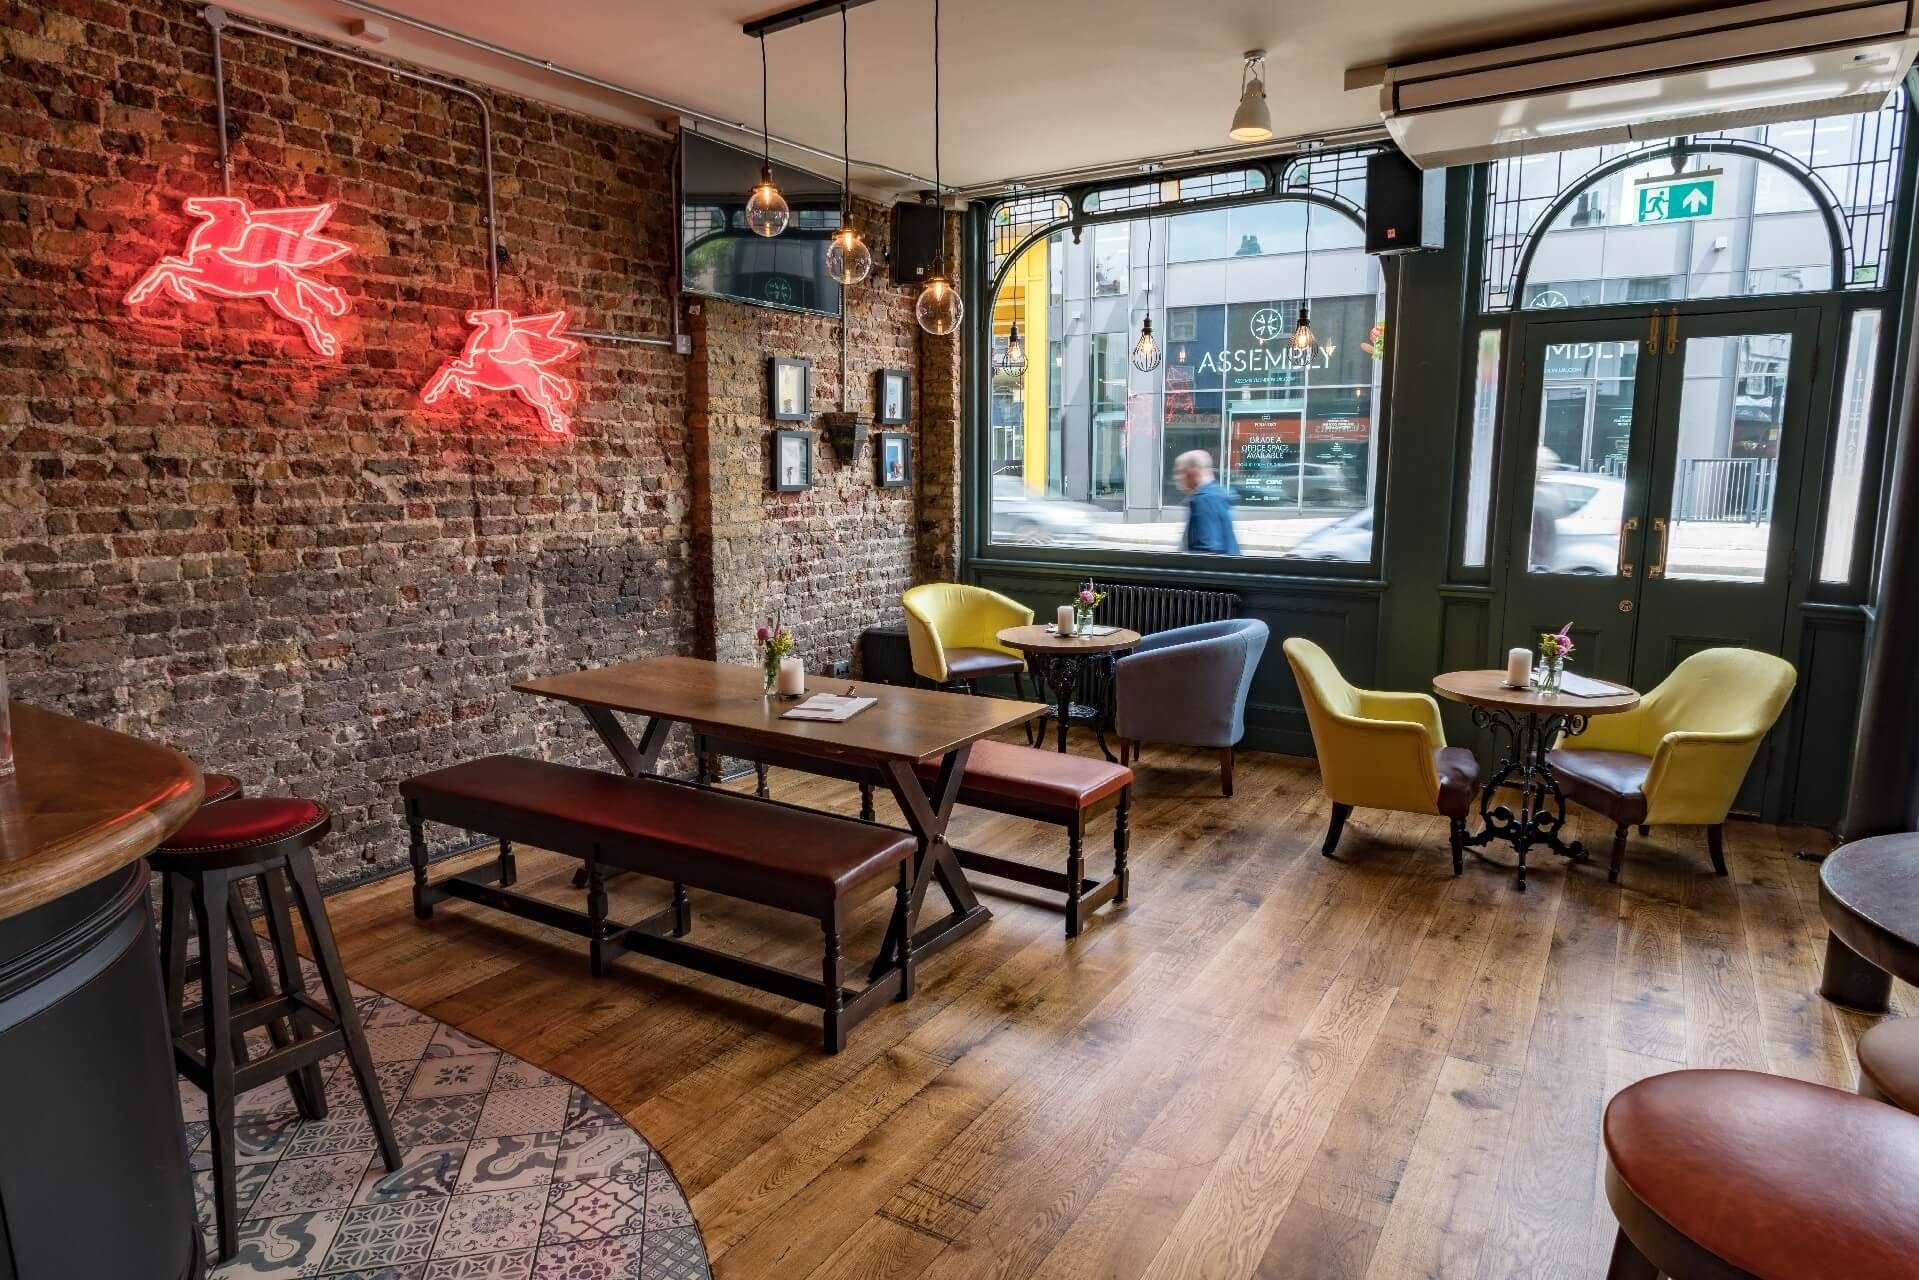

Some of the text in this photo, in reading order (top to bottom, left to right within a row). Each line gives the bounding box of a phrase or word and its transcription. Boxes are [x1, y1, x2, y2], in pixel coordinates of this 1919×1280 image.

[1198, 345, 1336, 374] ASSEMBLY
[1249, 436, 1275, 444] GRADE
[1241, 444, 1289, 452] OFFICE SPACE
